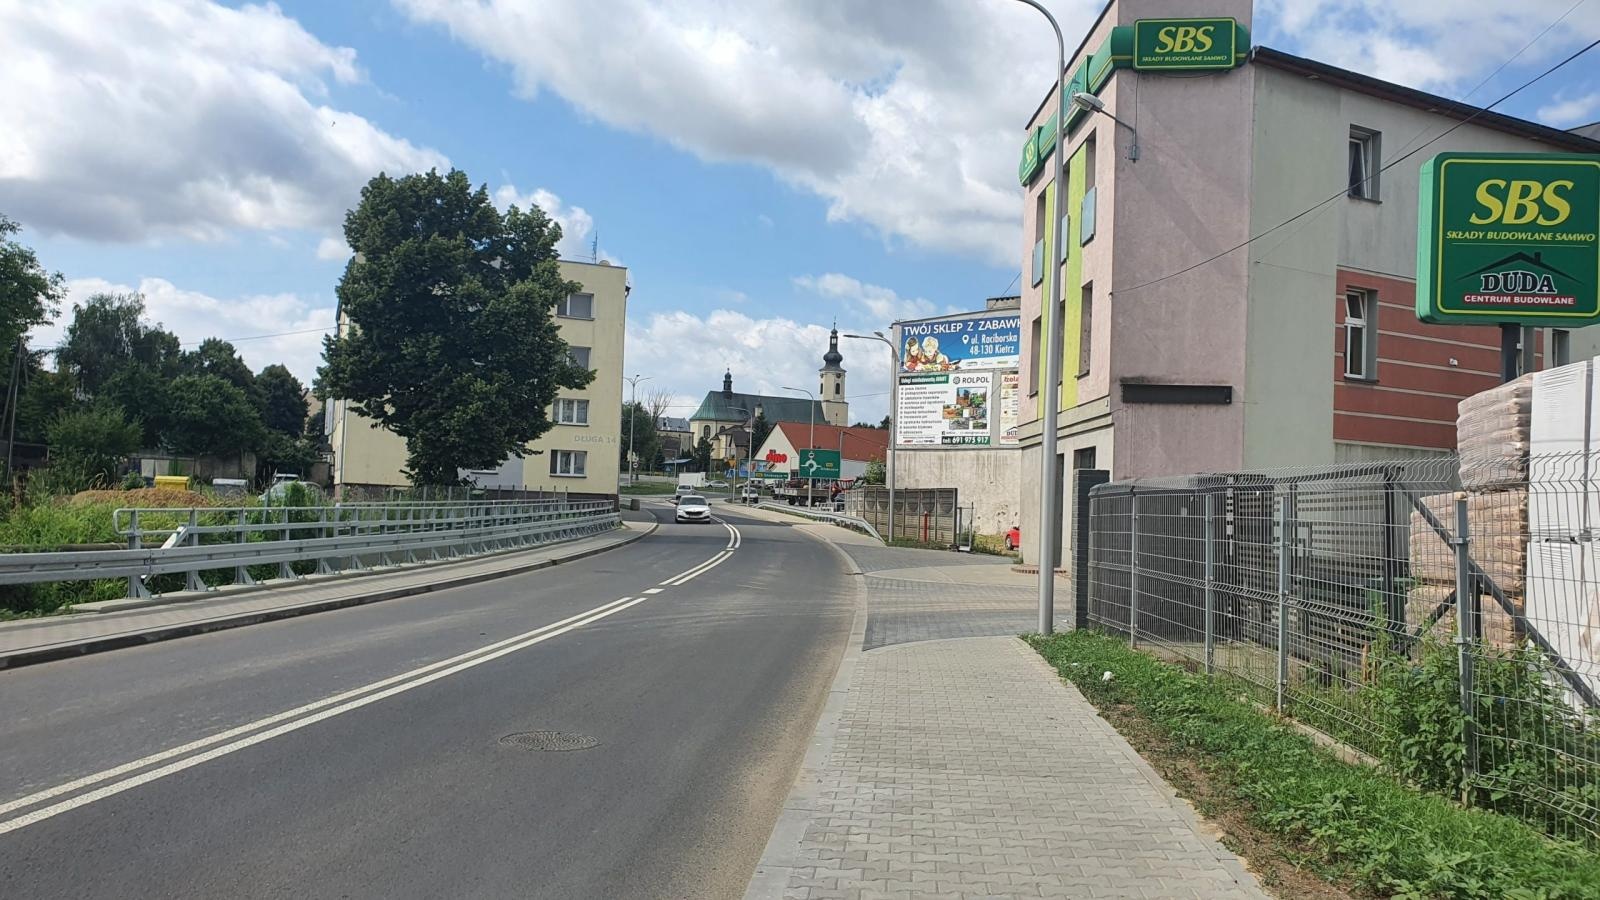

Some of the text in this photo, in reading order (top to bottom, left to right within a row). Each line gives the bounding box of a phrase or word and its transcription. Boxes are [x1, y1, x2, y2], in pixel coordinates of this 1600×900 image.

[1154, 26, 1215, 53] SBS
[1469, 179, 1574, 226] SBS
[1446, 230, 1596, 242] SKŁADY BUDOWLANE SAMWO
[1480, 270, 1557, 294] DUDA
[1464, 294, 1575, 305] CENTRUM BUDOWLANE
[903, 323, 932, 336] TWÓJ
[933, 322, 963, 334] SKLEP
[967, 321, 974, 332] Z
[981, 332, 1018, 344] Raciborska
[969, 343, 1015, 356] 48-130 Kietrz
[962, 376, 990, 384] ROLPOL
